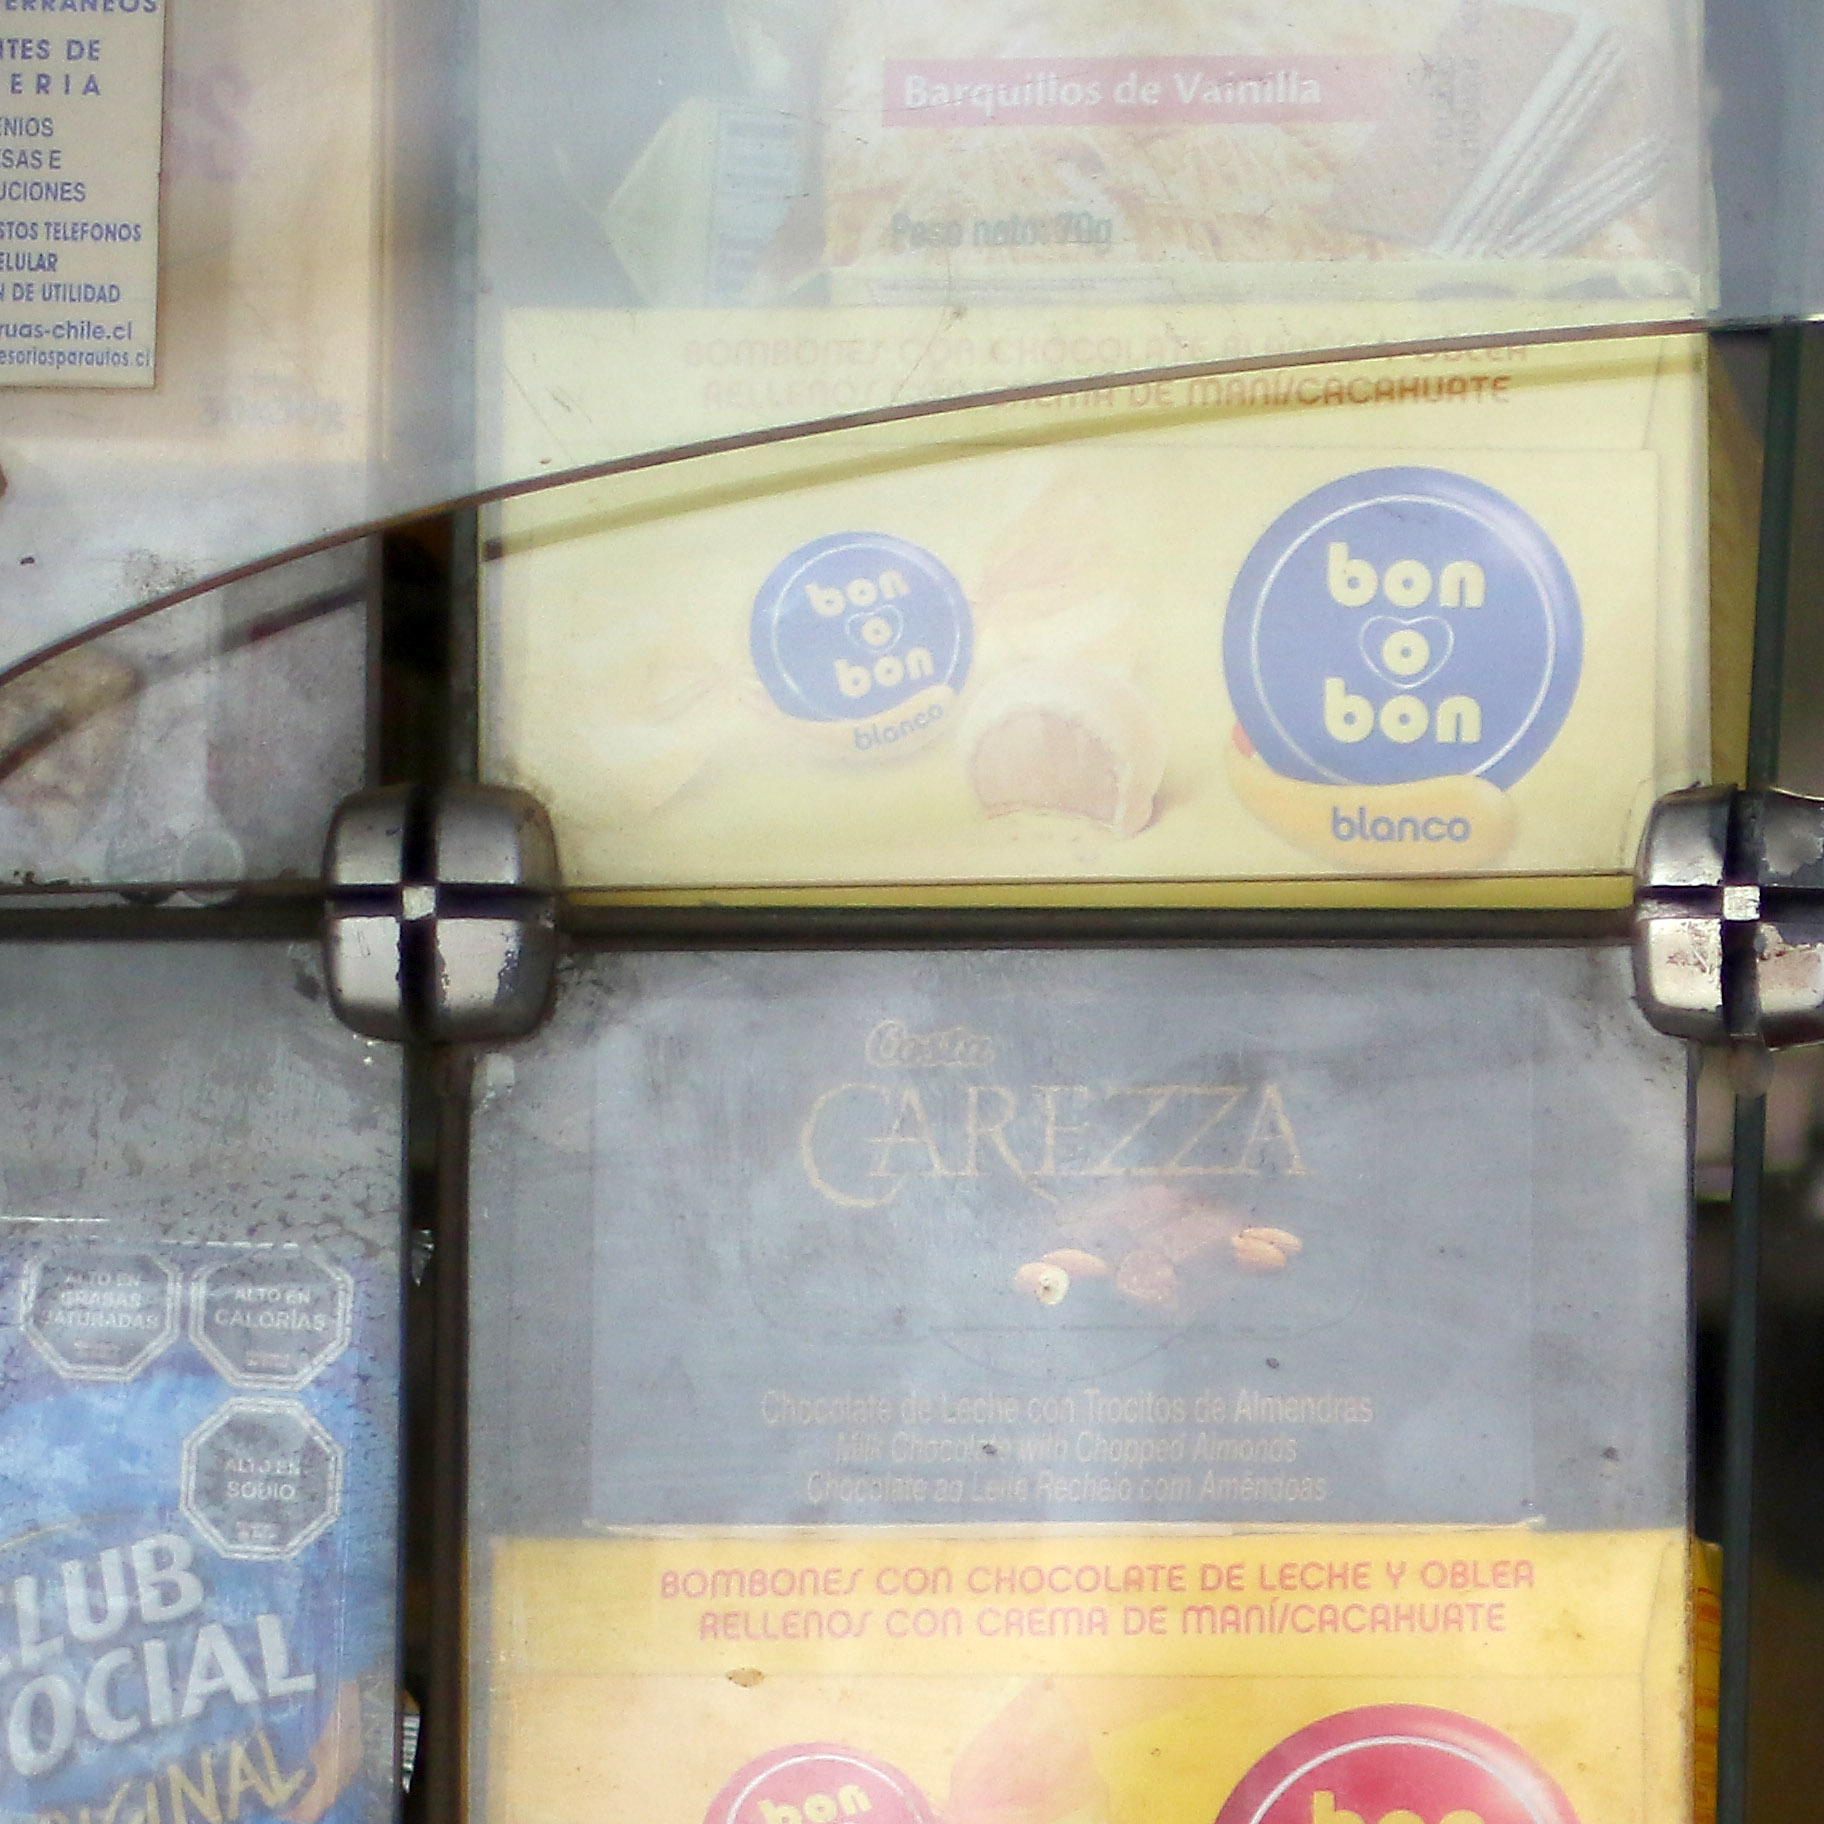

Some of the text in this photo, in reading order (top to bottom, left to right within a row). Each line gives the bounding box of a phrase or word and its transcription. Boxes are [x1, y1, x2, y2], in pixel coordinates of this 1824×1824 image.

[66, 39, 100, 61] DE
[904, 70, 1323, 116] Barquillos de Vainilla
[49, 150, 62, 170] E
[44, 221, 142, 242] TELEFONOS
[12, 282, 121, 304] DE UTILIDAD
[804, 570, 910, 617] bon
[1328, 541, 1486, 608] bon
[834, 647, 935, 698] bon
[1323, 676, 1483, 744] bon
[1331, 805, 1472, 843] blanco
[800, 1082, 1309, 1207] CAREZZA
[660, 1558, 1536, 1599] BOMBONES CON CHOCOLATE DE LECHE Y OBLEA
[0, 1531, 207, 1676] LUB
[698, 1608, 874, 1641] RELLENOS
[885, 1607, 963, 1639] CON
[976, 1605, 1109, 1638] CREMA
[1123, 1604, 1168, 1636] DE
